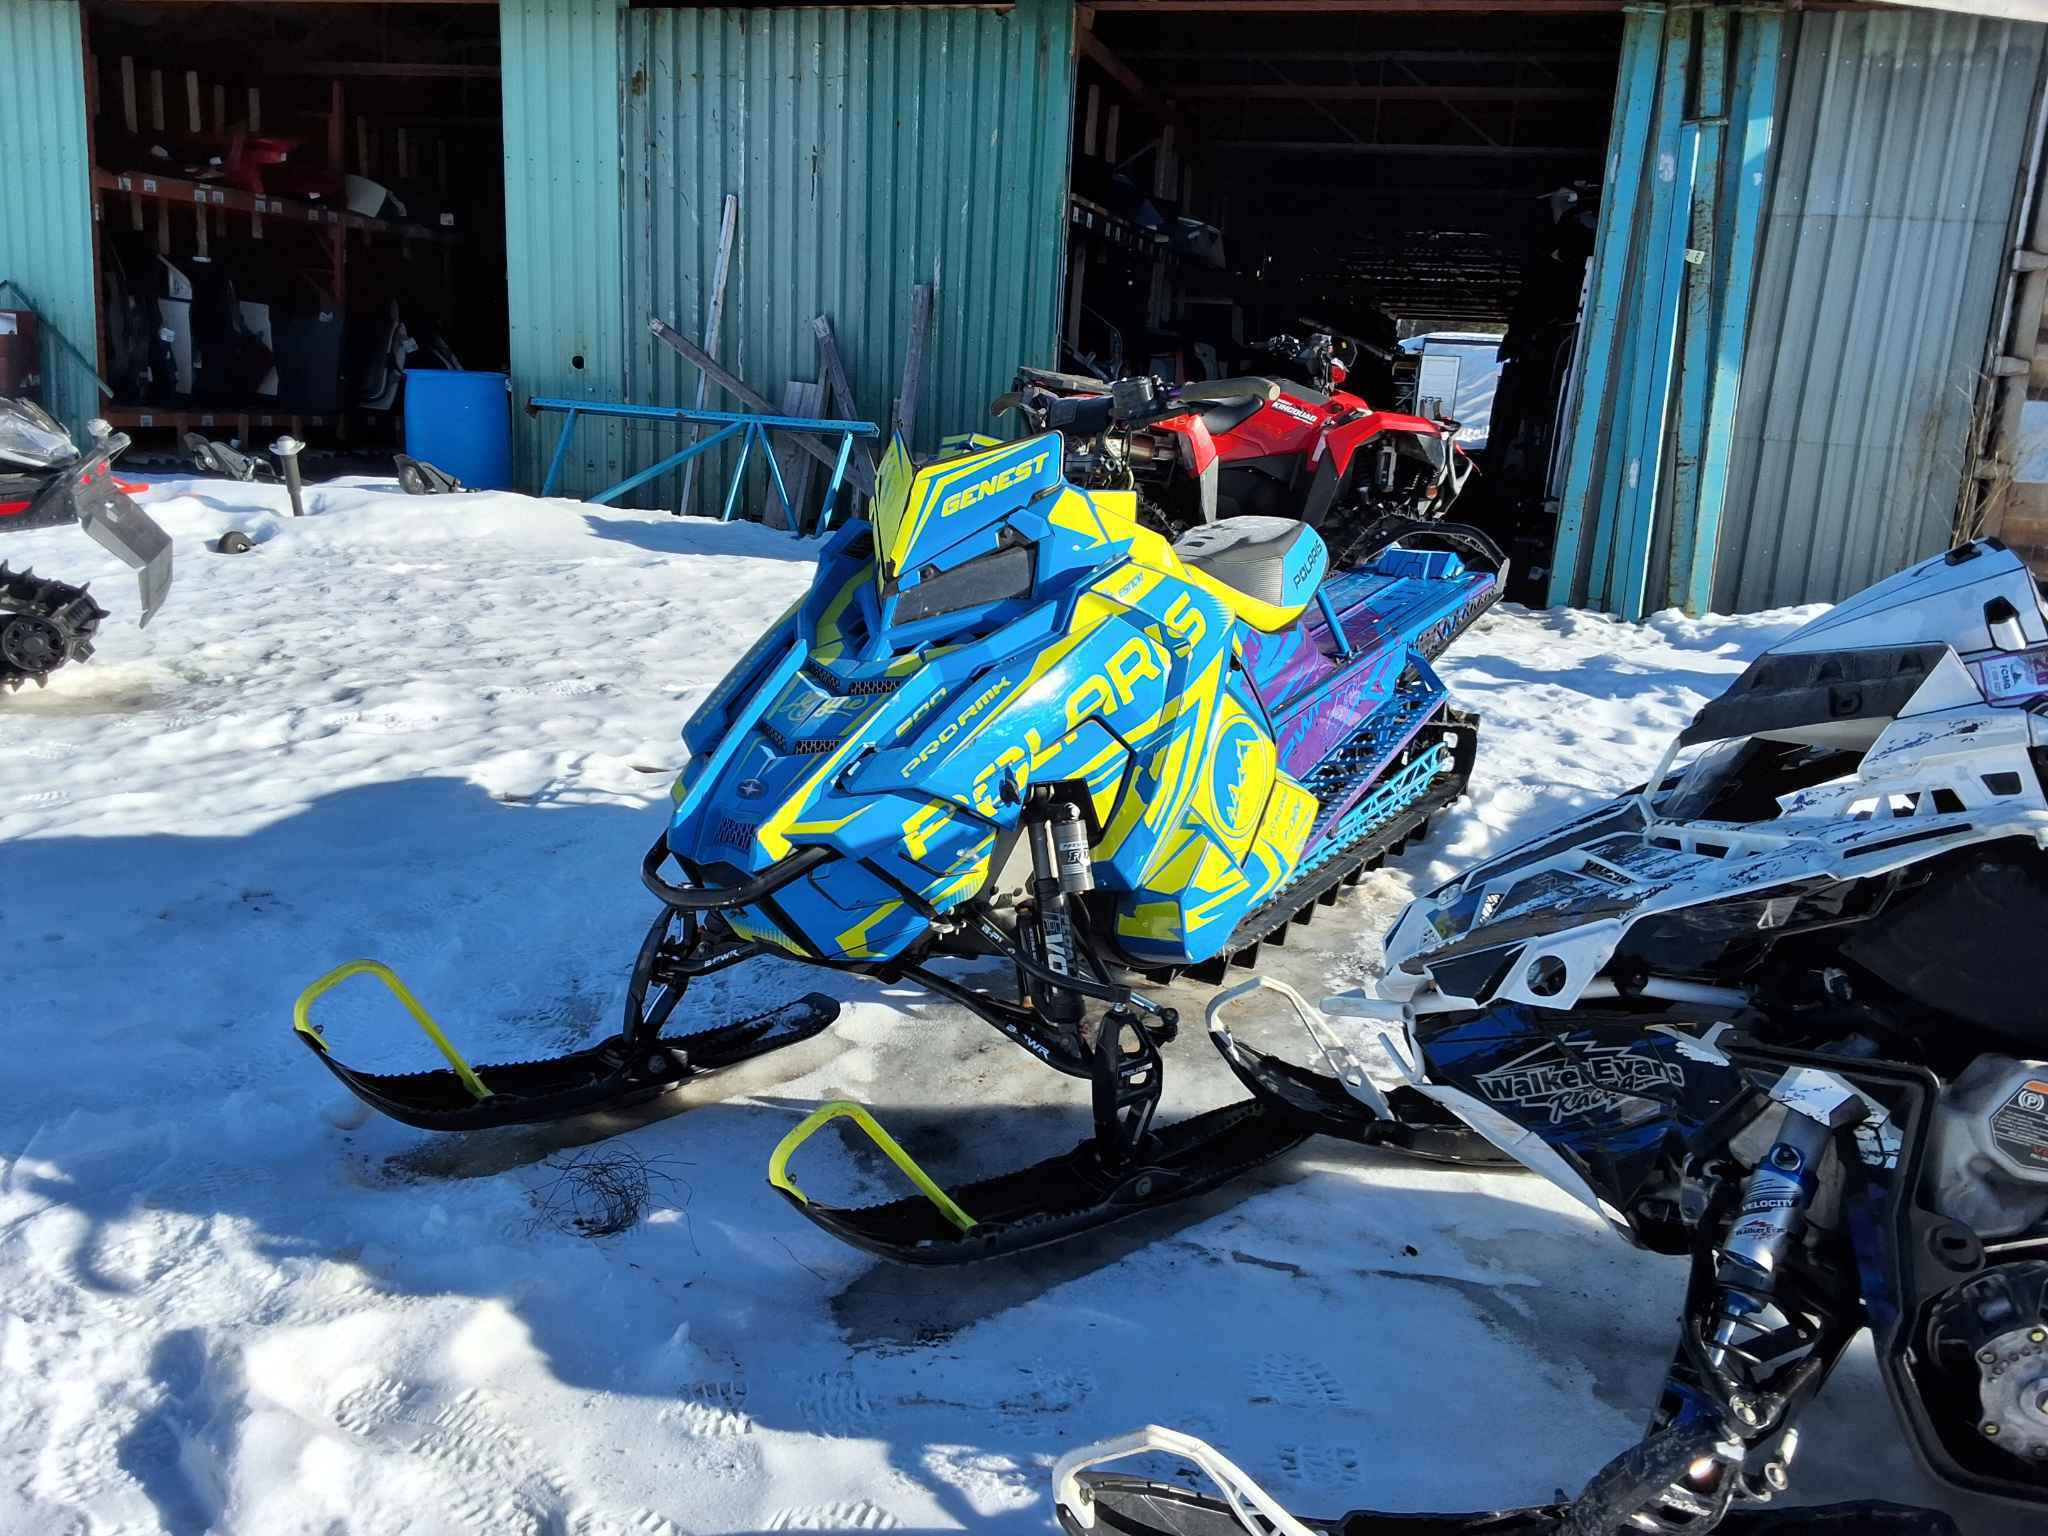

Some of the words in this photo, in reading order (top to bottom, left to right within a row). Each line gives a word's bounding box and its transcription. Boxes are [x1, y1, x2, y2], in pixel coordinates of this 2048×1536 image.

[941, 451, 1050, 518] GENEST
[1293, 539, 1323, 592] POLARIS
[901, 723, 959, 778] PRO
[957, 676, 1012, 727] RMK
[1743, 1199, 1794, 1211] VELOCITY
